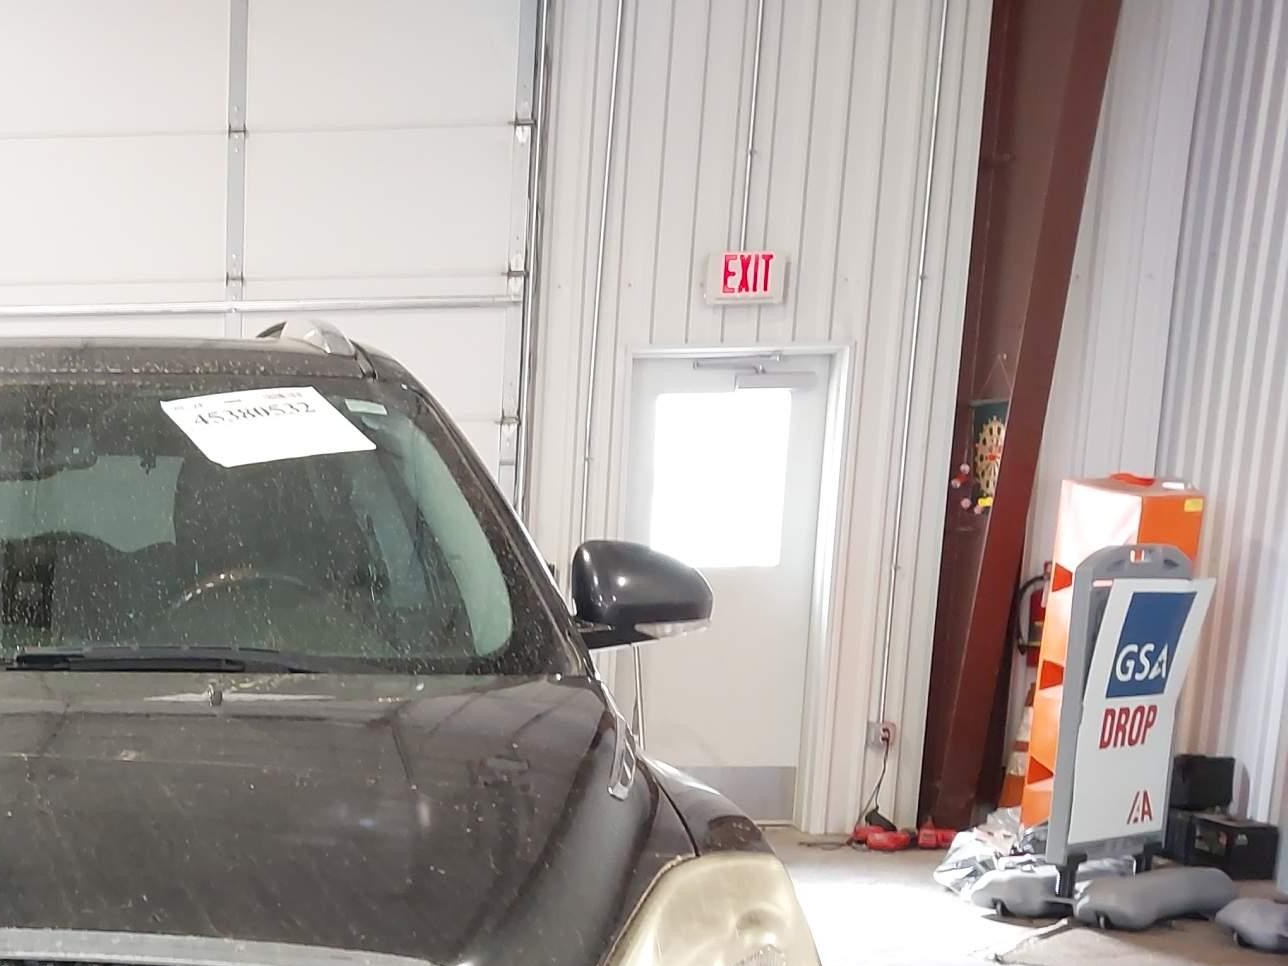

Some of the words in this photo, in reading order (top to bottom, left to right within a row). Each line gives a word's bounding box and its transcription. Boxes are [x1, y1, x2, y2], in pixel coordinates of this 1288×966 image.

[722, 254, 774, 293] EXIT
[1115, 643, 1168, 682] GSA
[1099, 704, 1158, 749] DROP
